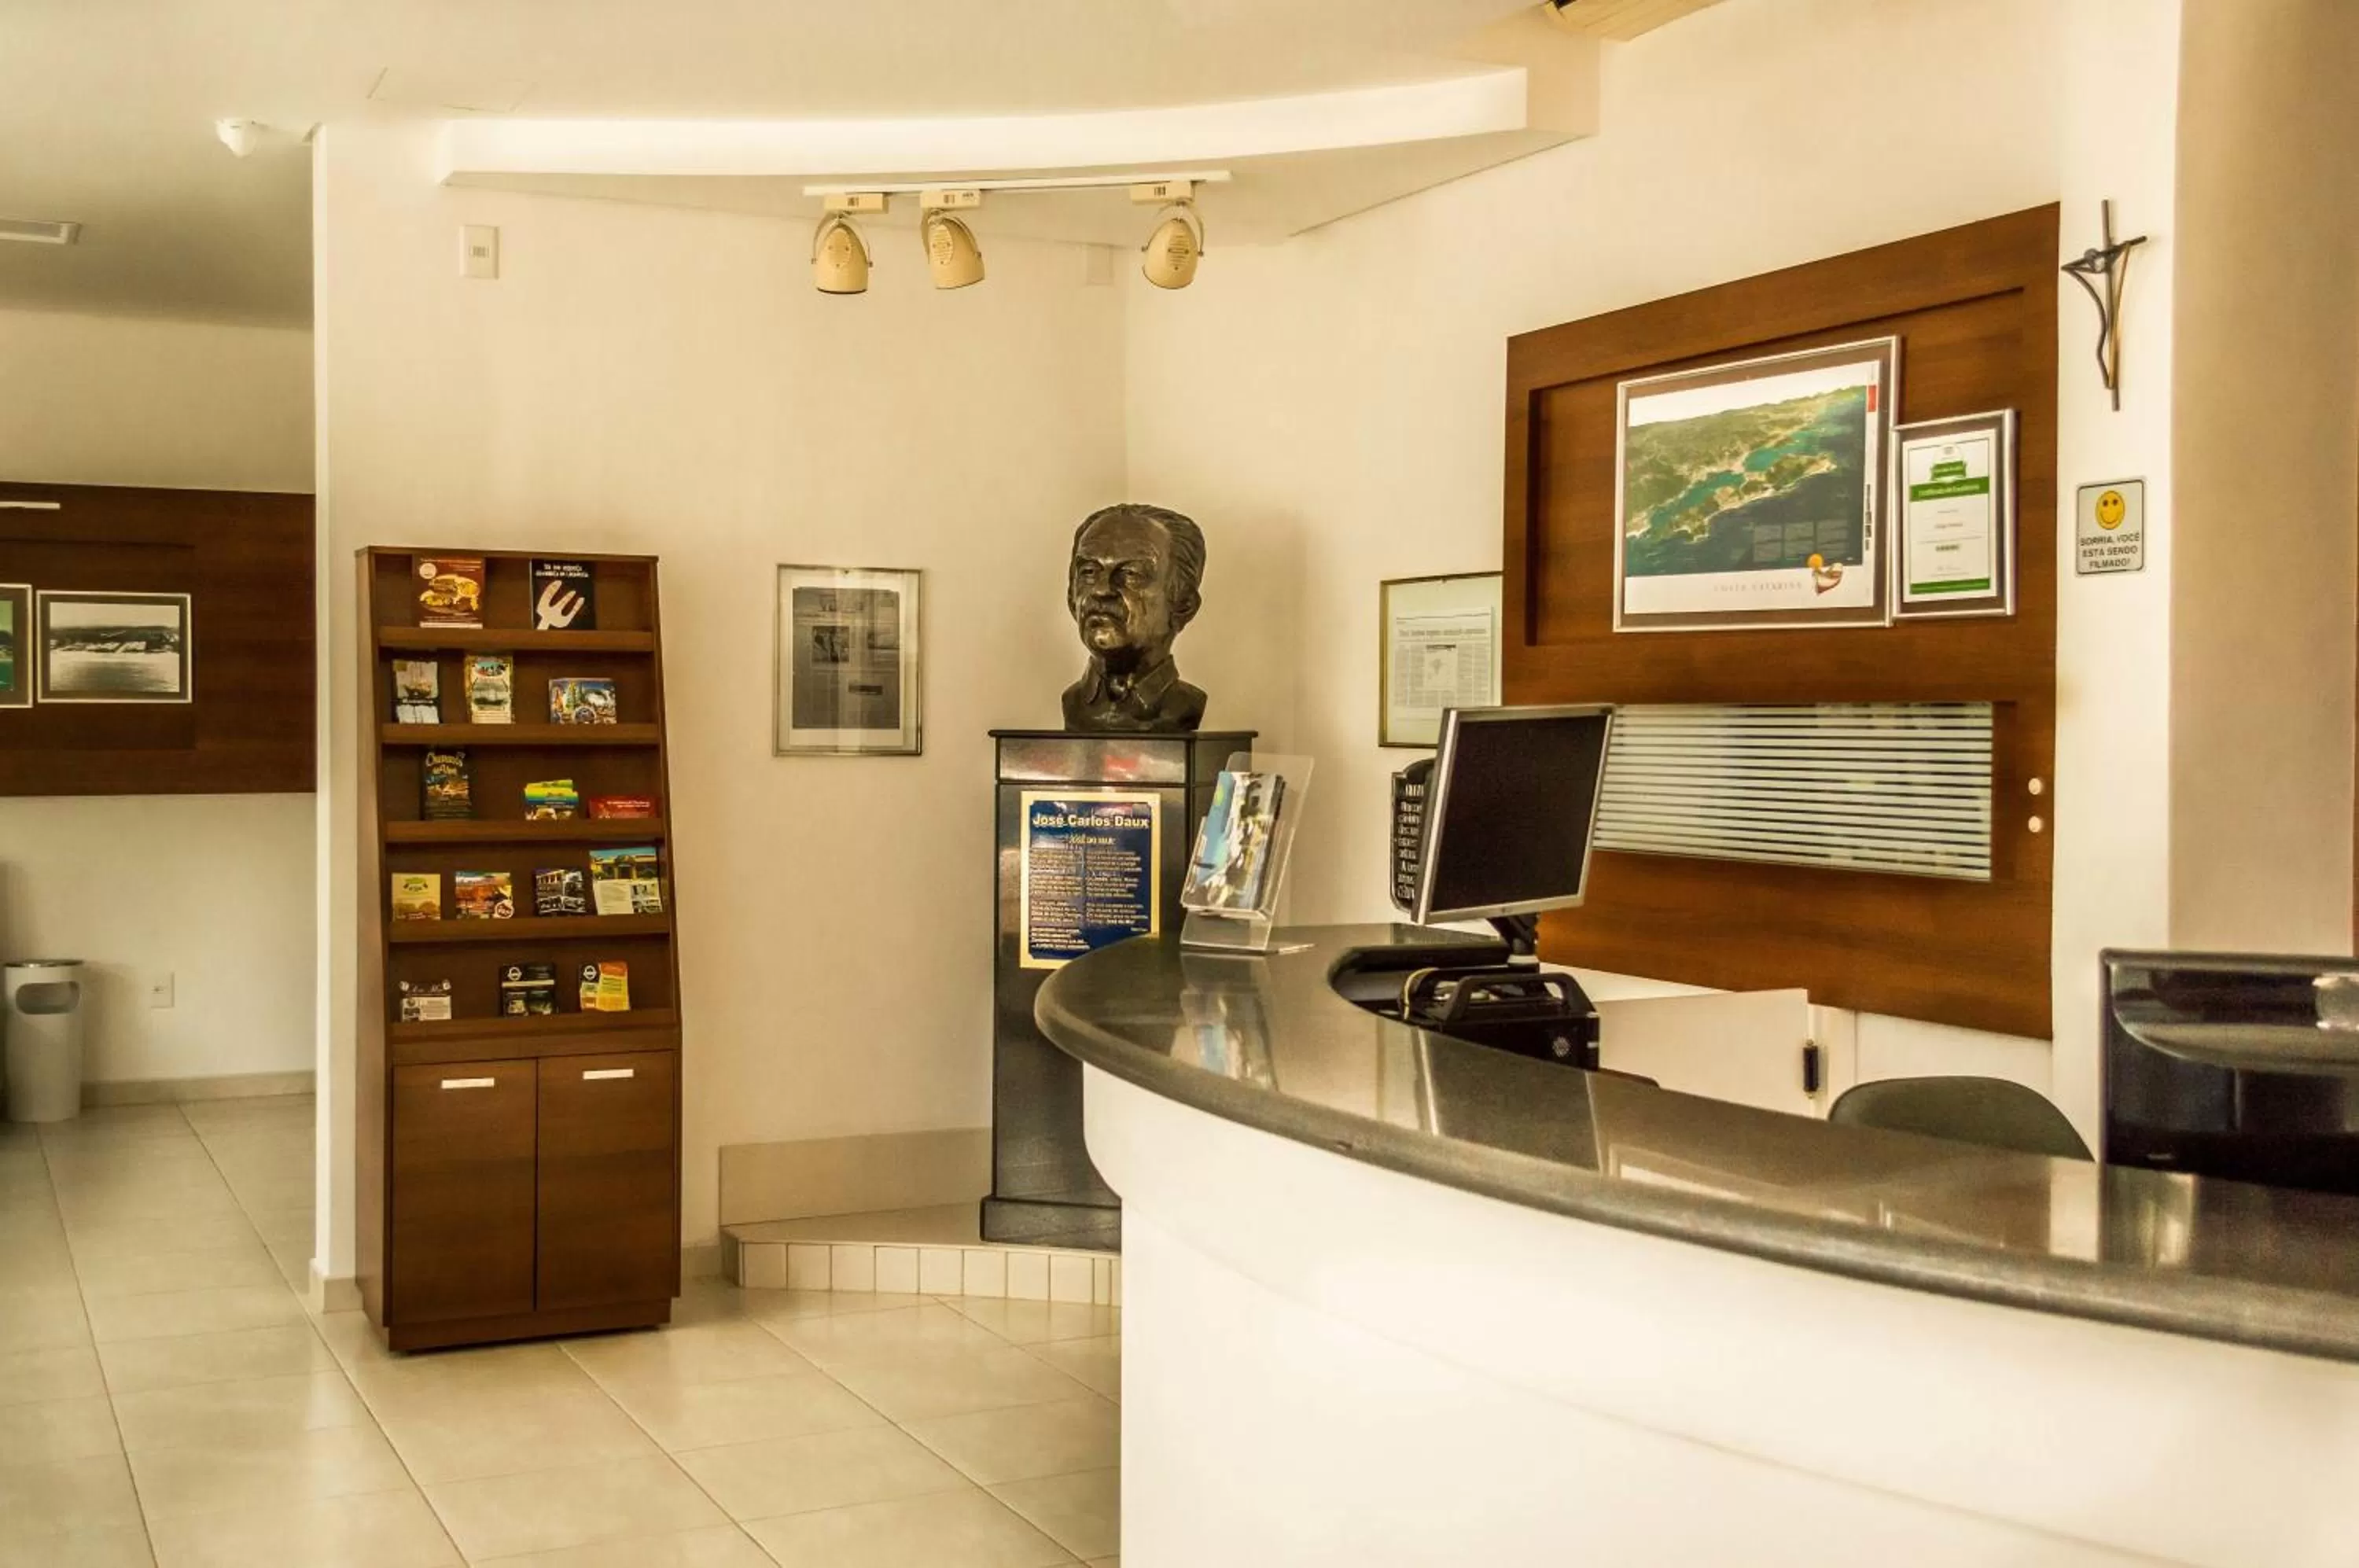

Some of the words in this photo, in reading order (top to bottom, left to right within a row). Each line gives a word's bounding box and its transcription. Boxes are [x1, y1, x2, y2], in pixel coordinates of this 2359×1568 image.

[2107, 545, 2138, 556] SENDO
[1032, 812, 1063, 827] José
[1068, 814, 1111, 827] Carlos
[1114, 815, 1150, 828] Daux
